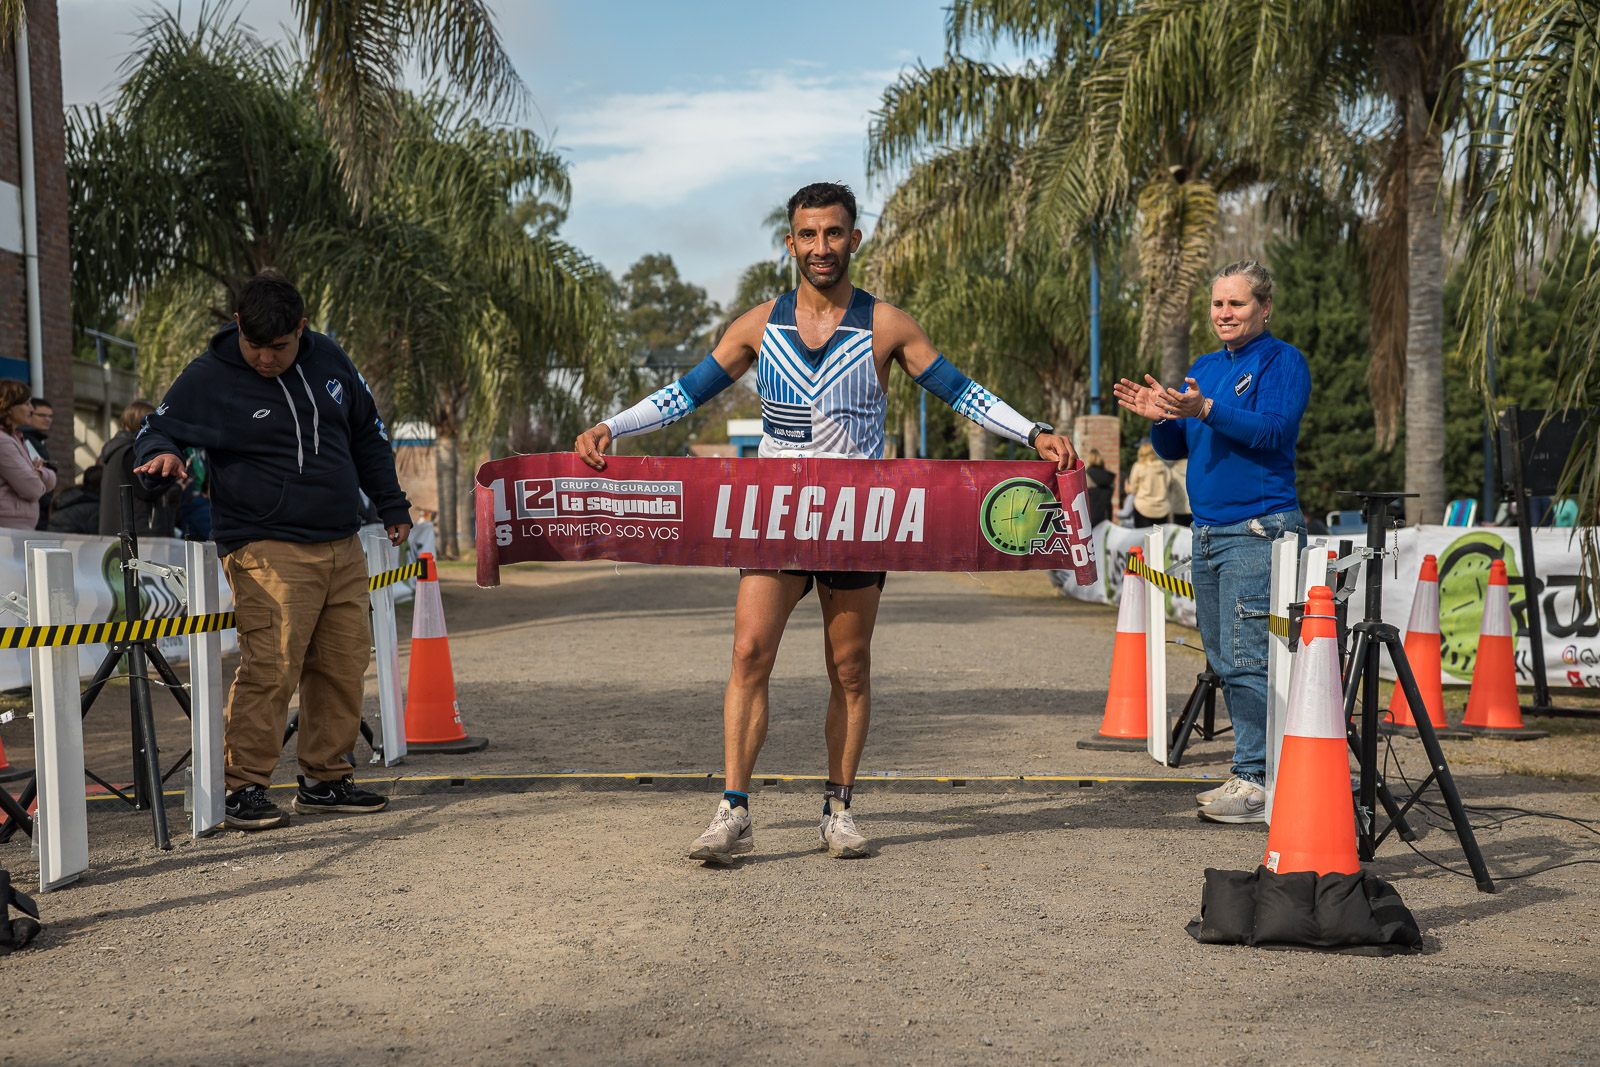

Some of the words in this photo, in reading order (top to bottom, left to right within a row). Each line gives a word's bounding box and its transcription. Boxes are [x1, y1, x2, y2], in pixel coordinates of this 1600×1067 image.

[560, 481, 599, 490] GRUPO
[602, 482, 676, 493] ASEGURADOR
[713, 484, 926, 542] LLEGADA
[522, 524, 544, 538] LO
[549, 522, 612, 537] PRIMERO
[616, 524, 645, 539] SOS
[648, 526, 680, 541] VOS
